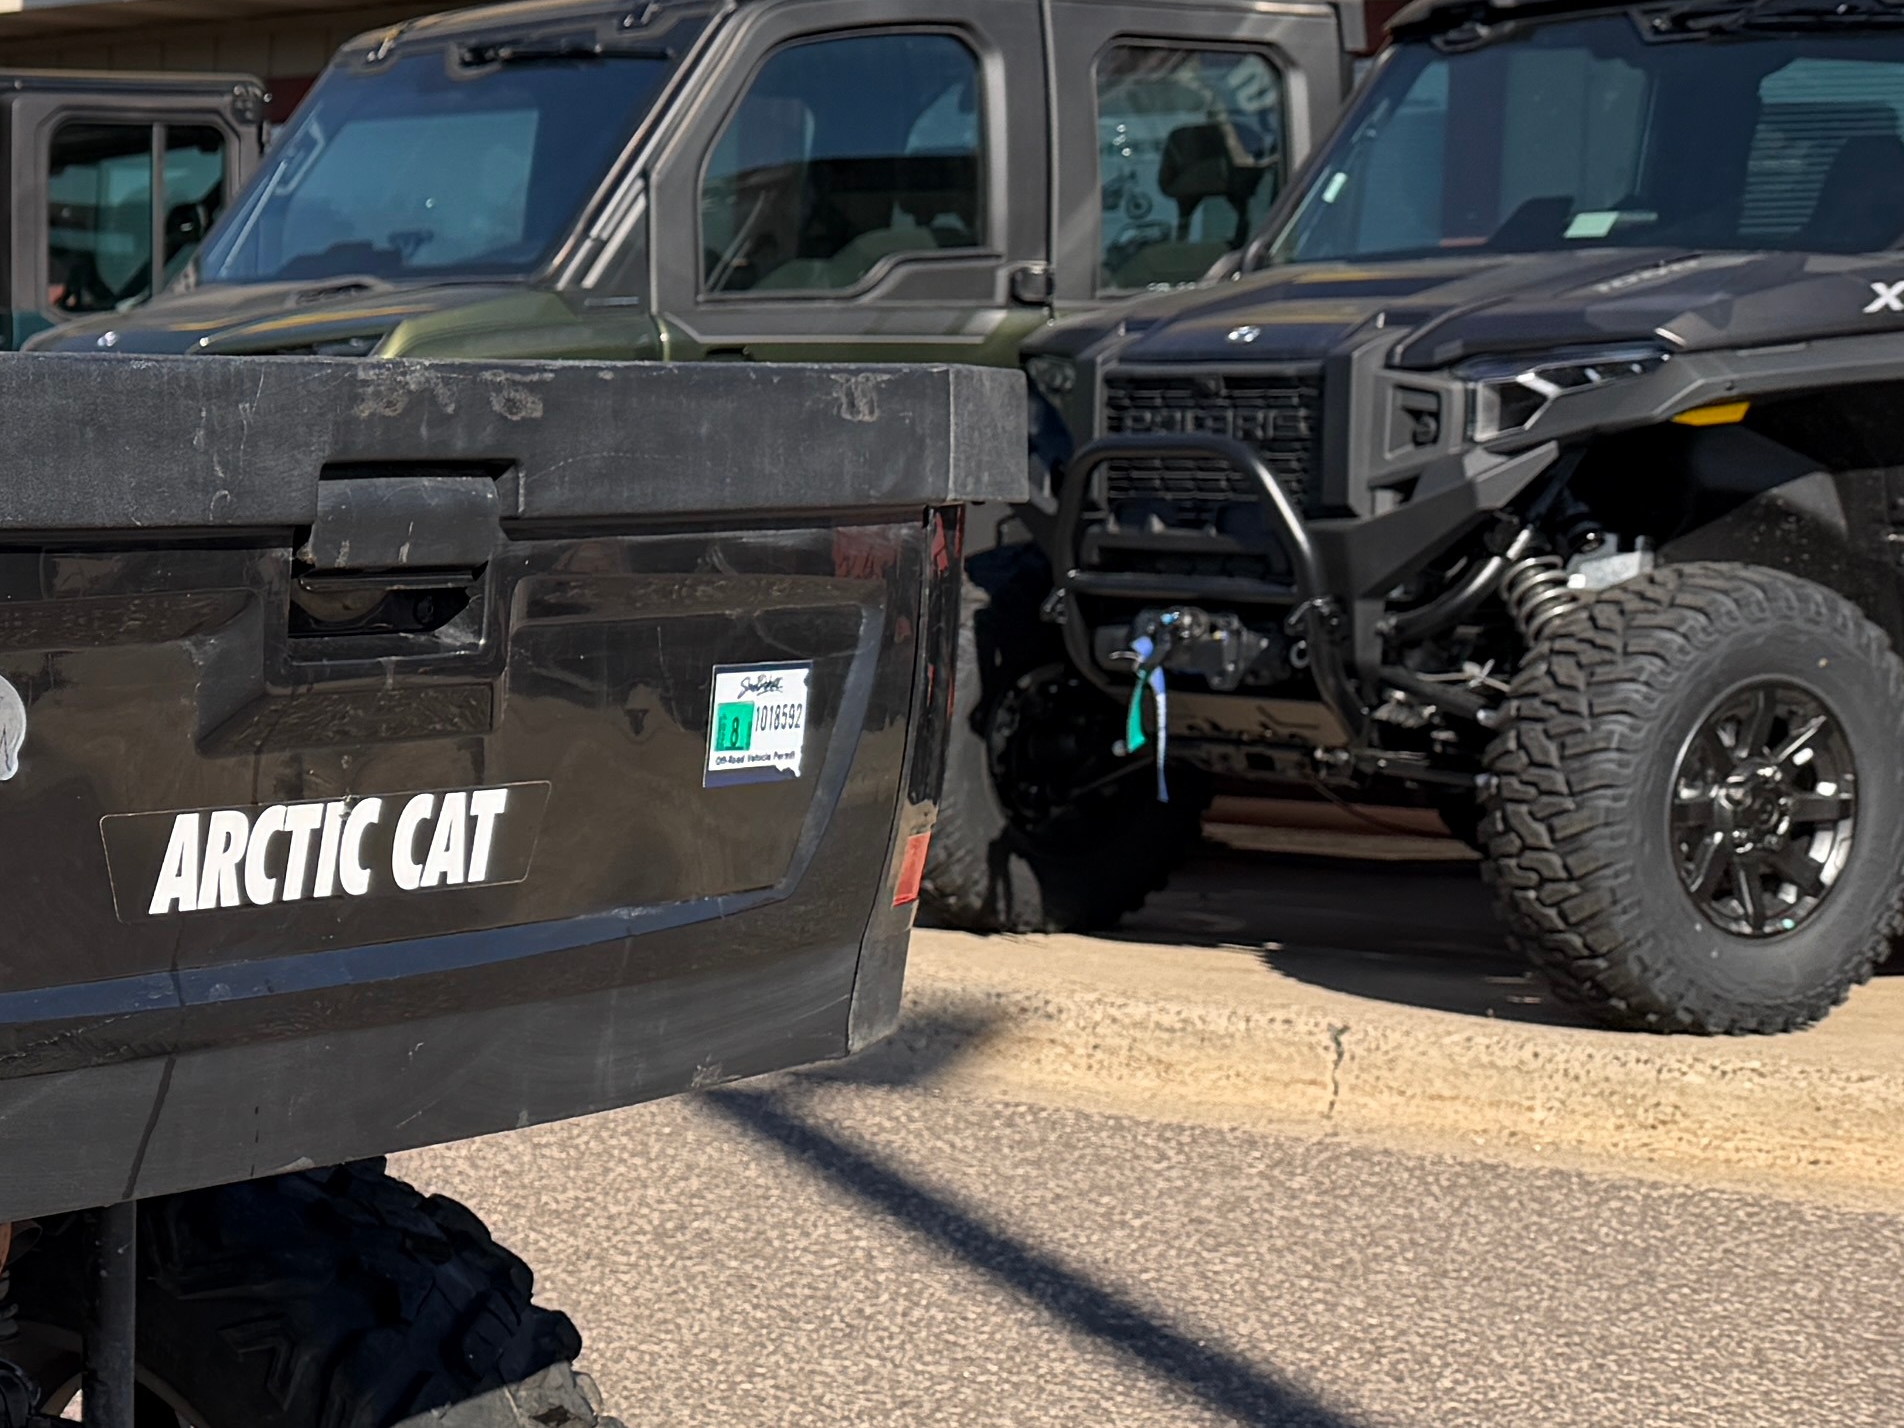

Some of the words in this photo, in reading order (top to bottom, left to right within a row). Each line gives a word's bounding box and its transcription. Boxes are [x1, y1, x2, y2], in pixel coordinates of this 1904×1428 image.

[755, 703, 803, 732] 1018592
[148, 797, 383, 916] ARCTIC
[392, 788, 509, 891] CAT
